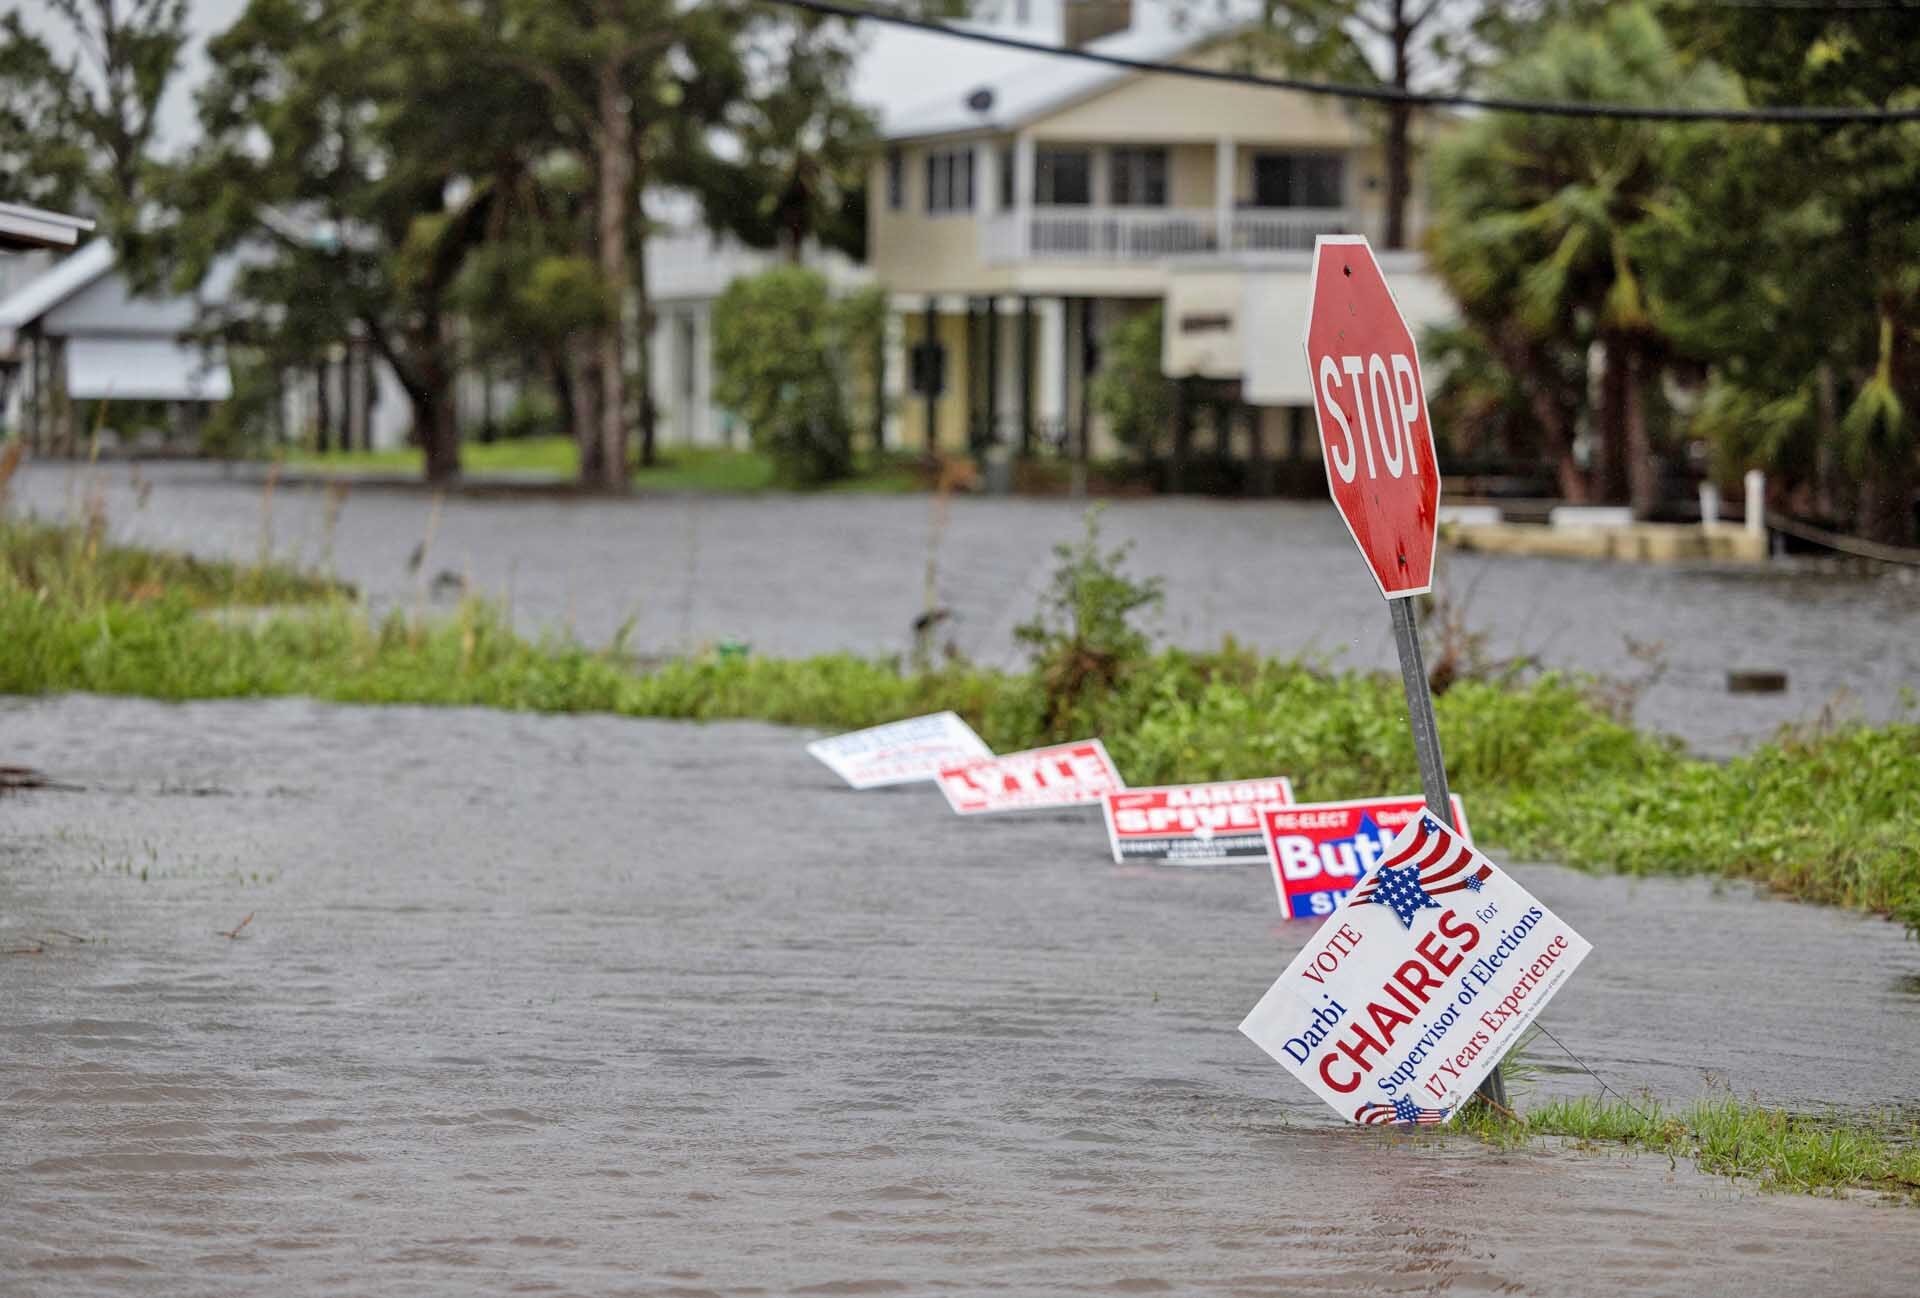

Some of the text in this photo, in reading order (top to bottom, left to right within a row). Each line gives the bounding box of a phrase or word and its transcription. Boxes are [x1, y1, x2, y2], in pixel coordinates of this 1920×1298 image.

[1320, 353, 1418, 483] STOP
[1275, 811, 1349, 829] RE-ELECT
[1302, 923, 1362, 985] VOTE
[1319, 902, 1498, 1093] CHAIRES for
[1378, 1003, 1460, 1096] Supervisor
[1458, 977, 1479, 1005] of
[1470, 906, 1543, 986] Elections
[1424, 1074, 1448, 1100] 17
[1440, 1031, 1489, 1080] Years
[1480, 934, 1568, 1034] Experience
[1282, 994, 1347, 1065] Darbi
